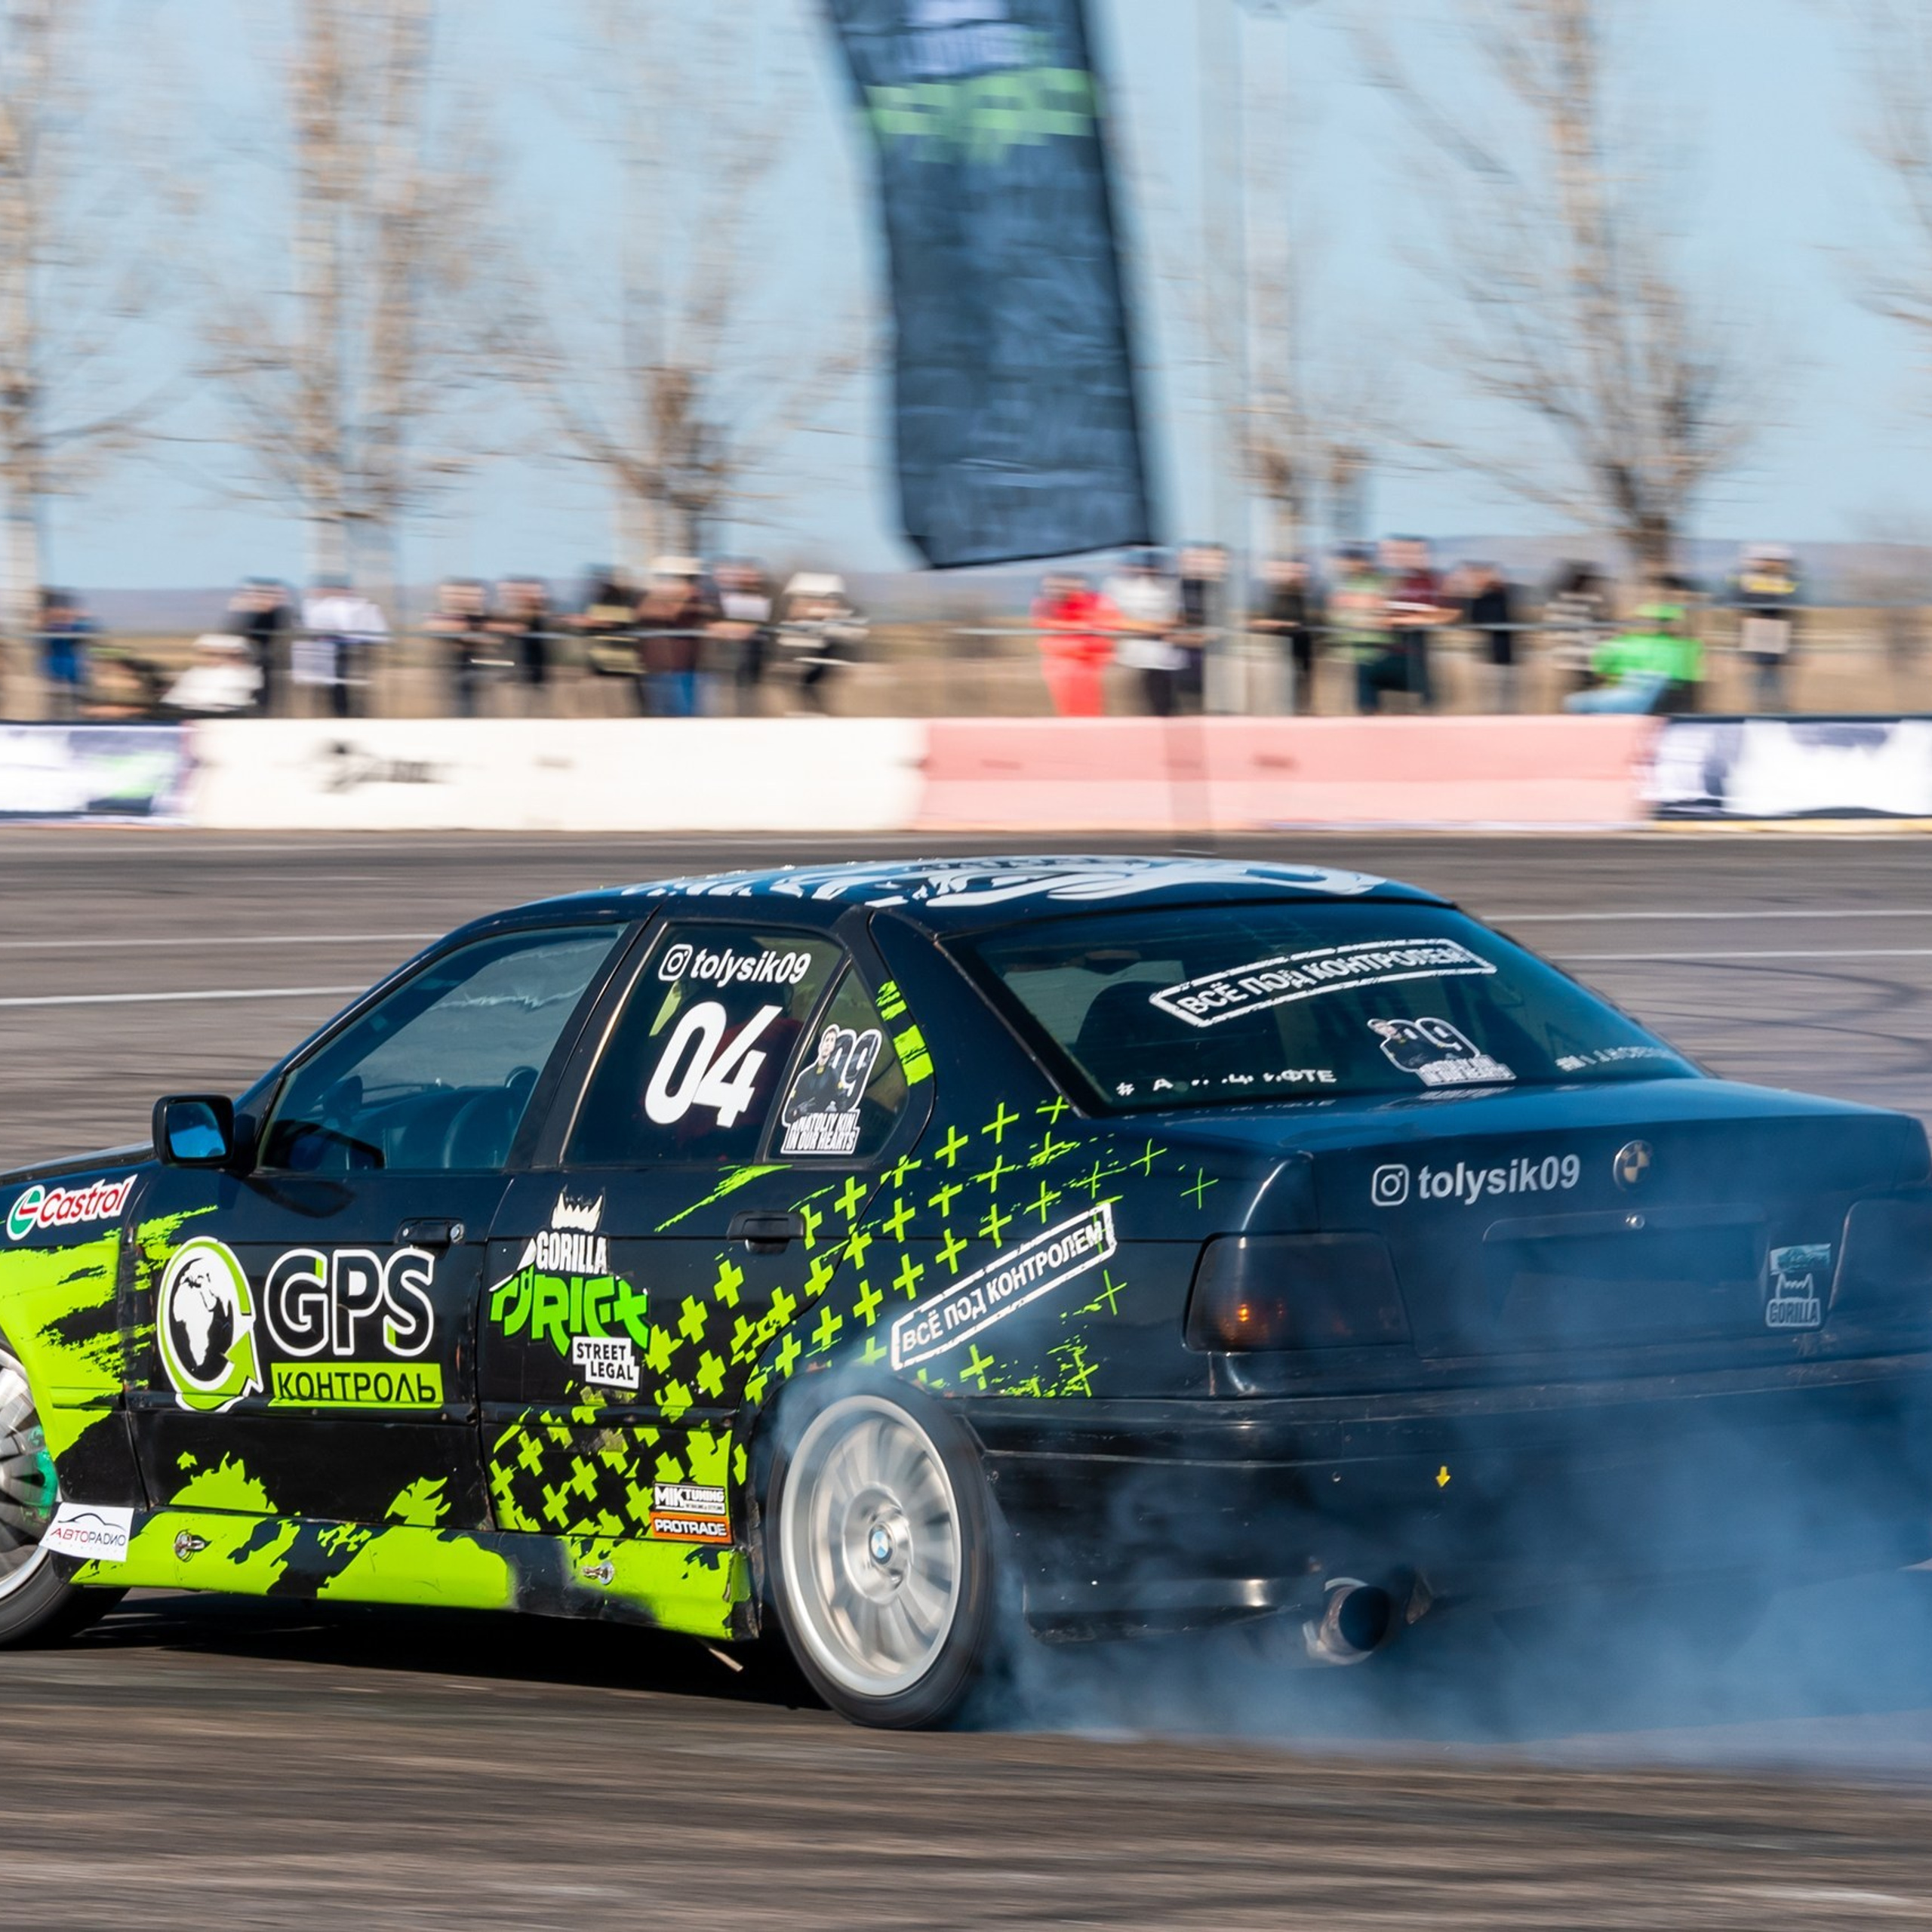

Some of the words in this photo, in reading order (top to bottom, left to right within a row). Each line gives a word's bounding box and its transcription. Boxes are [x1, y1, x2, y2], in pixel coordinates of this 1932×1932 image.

[690, 948, 812, 988] tolysik09
[1177, 982, 1249, 1014] ВСЁ
[1238, 970, 1318, 999] ПОД
[645, 1001, 783, 1128] 04
[786, 1131, 801, 1150] IN
[797, 1131, 820, 1150] OUR
[817, 1131, 857, 1150] HEARTS
[1418, 1154, 1581, 1205] tolysik09
[40, 1181, 131, 1223] Castrol
[536, 1231, 608, 1274] GORILLA
[263, 1247, 436, 1357] GPS
[902, 1309, 943, 1353] ВСЁ
[943, 1287, 988, 1330] ПОД
[986, 1220, 1103, 1305] КОНТРОЛЕМ
[576, 1343, 626, 1361] STREET
[590, 1361, 634, 1380] LEGAL
[277, 1371, 437, 1403] КОНТРОЛЬ
[50, 1527, 127, 1546] АВТОРАДИО
[654, 1518, 728, 1537] PROTRADE
